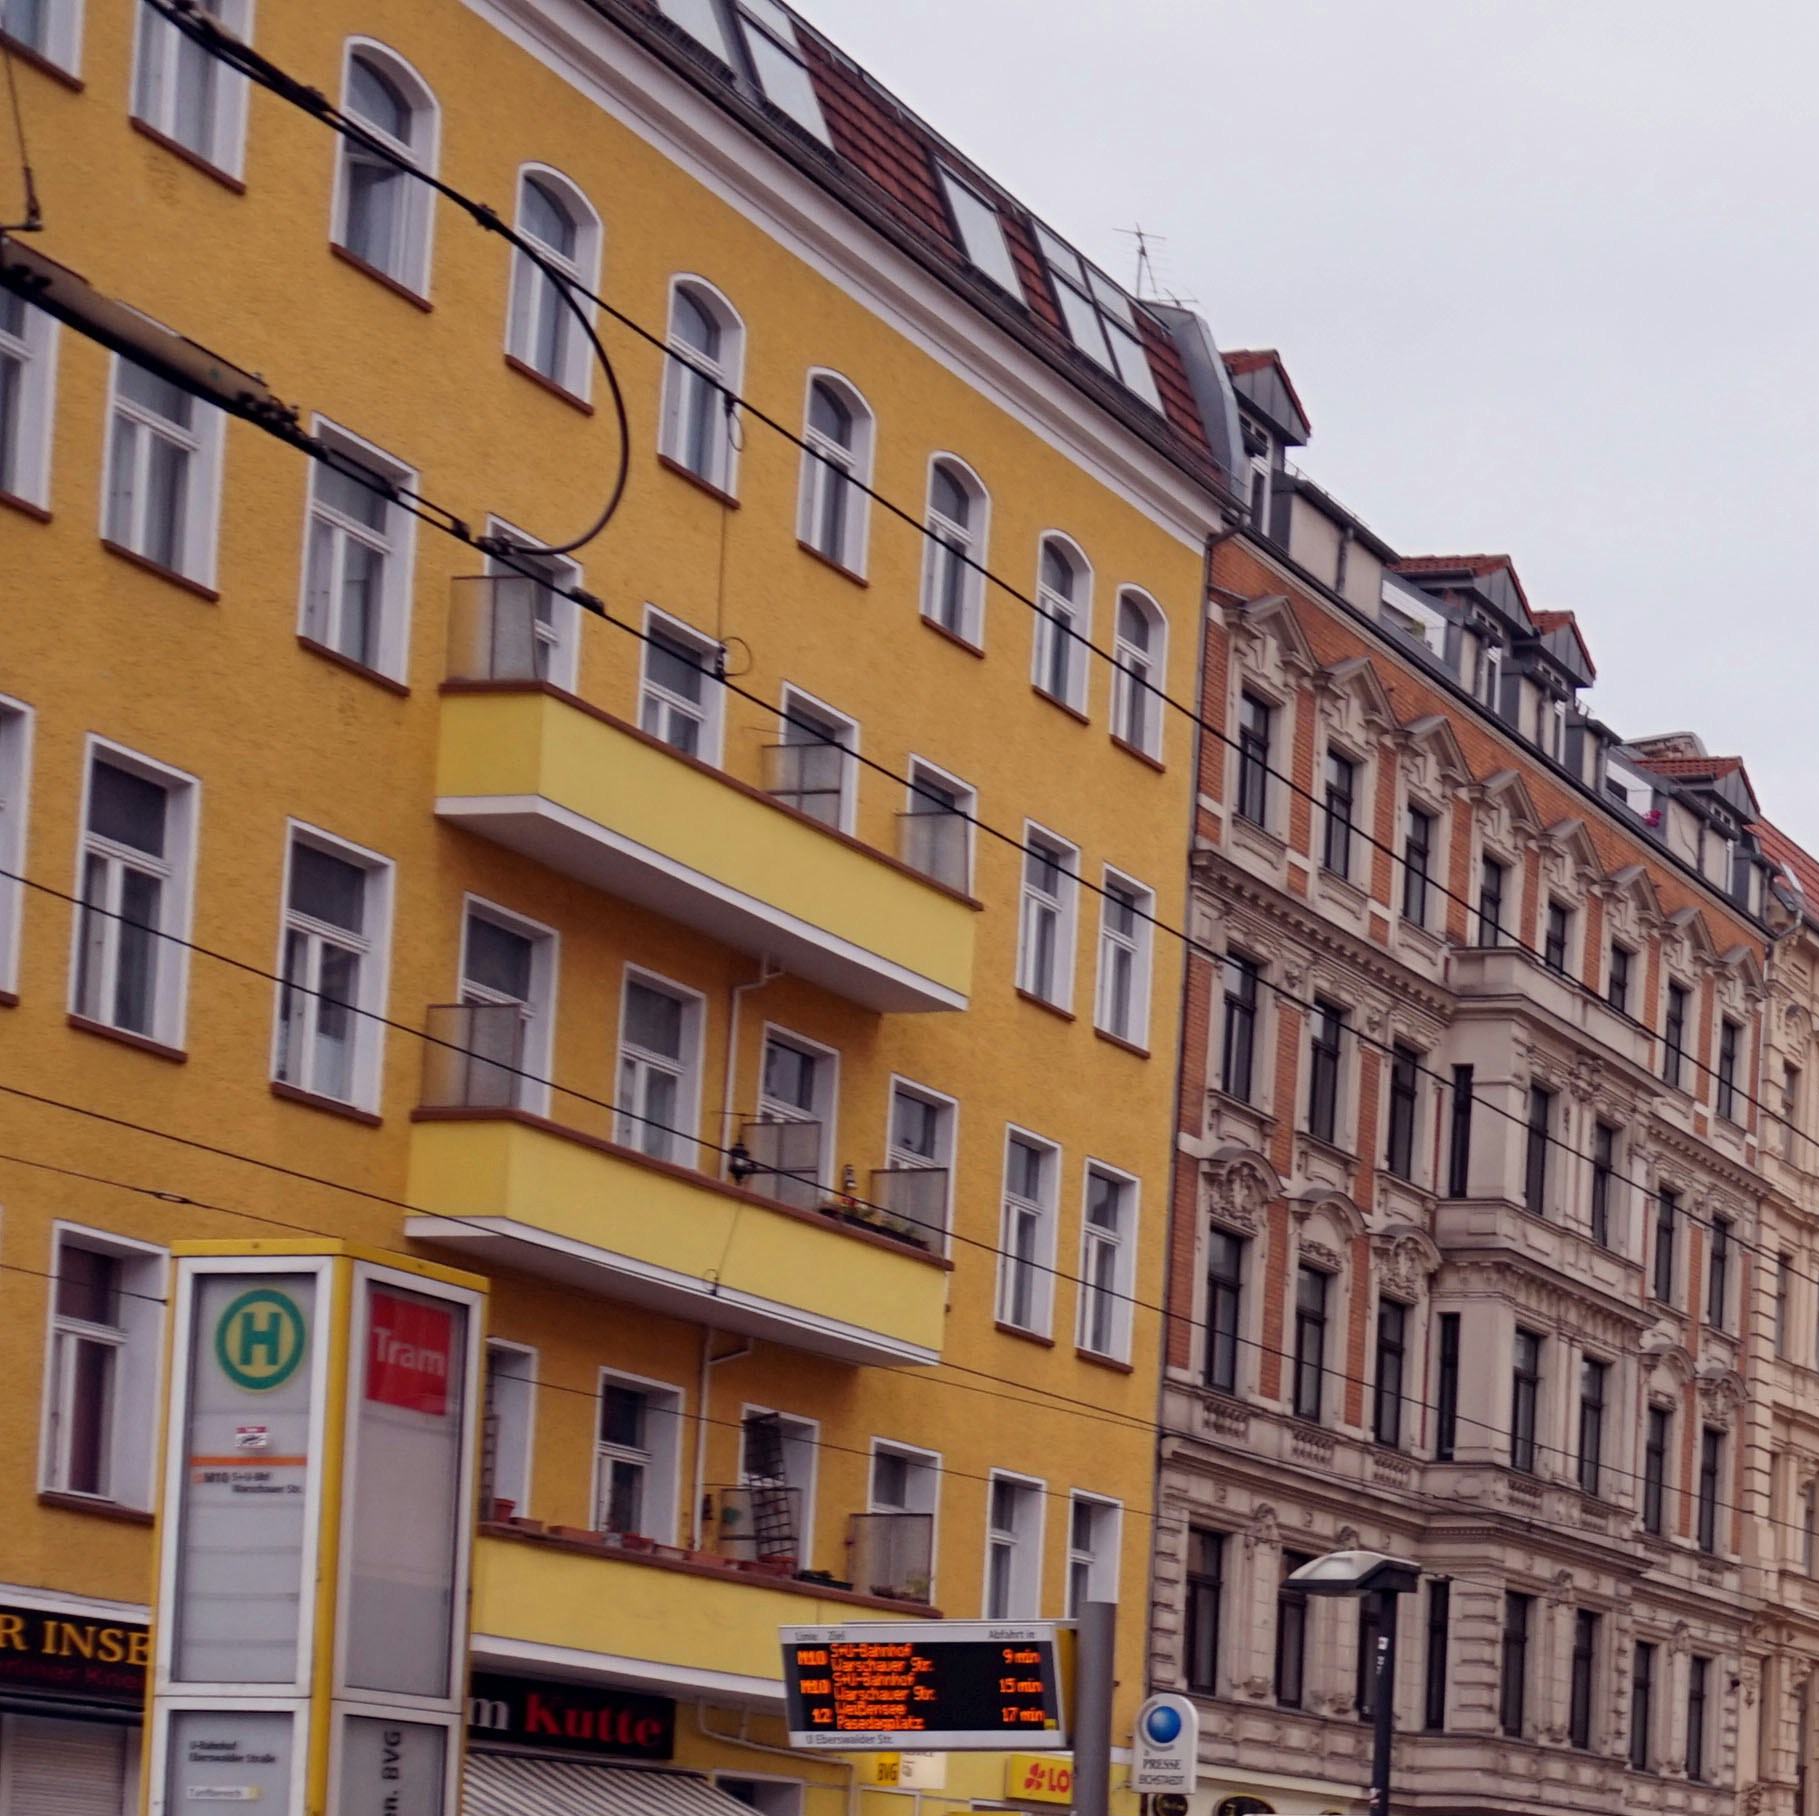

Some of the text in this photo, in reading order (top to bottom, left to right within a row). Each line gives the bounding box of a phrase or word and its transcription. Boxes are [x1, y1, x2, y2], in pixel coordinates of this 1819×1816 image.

[240, 1312, 282, 1366] H
[373, 1327, 445, 1377] Tram
[796, 1651, 828, 1665] M10
[1002, 1650, 1013, 1664] 9
[1014, 1650, 1041, 1663] min
[832, 1657, 935, 1672] Warschauer Str.
[800, 1680, 831, 1694] M10
[999, 1678, 1015, 1693] 15
[1016, 1678, 1043, 1693] min
[834, 1686, 936, 1701] Warschauer Str.
[811, 1702, 1045, 1723] 12 Weißensee 17 min
[528, 1696, 662, 1747] Kutte
[816, 1734, 875, 1745] Eberswalder
[383, 1731, 401, 1780] BVG
[878, 1763, 897, 1781] BVG
[1143, 1759, 1181, 1770] PRESSE
